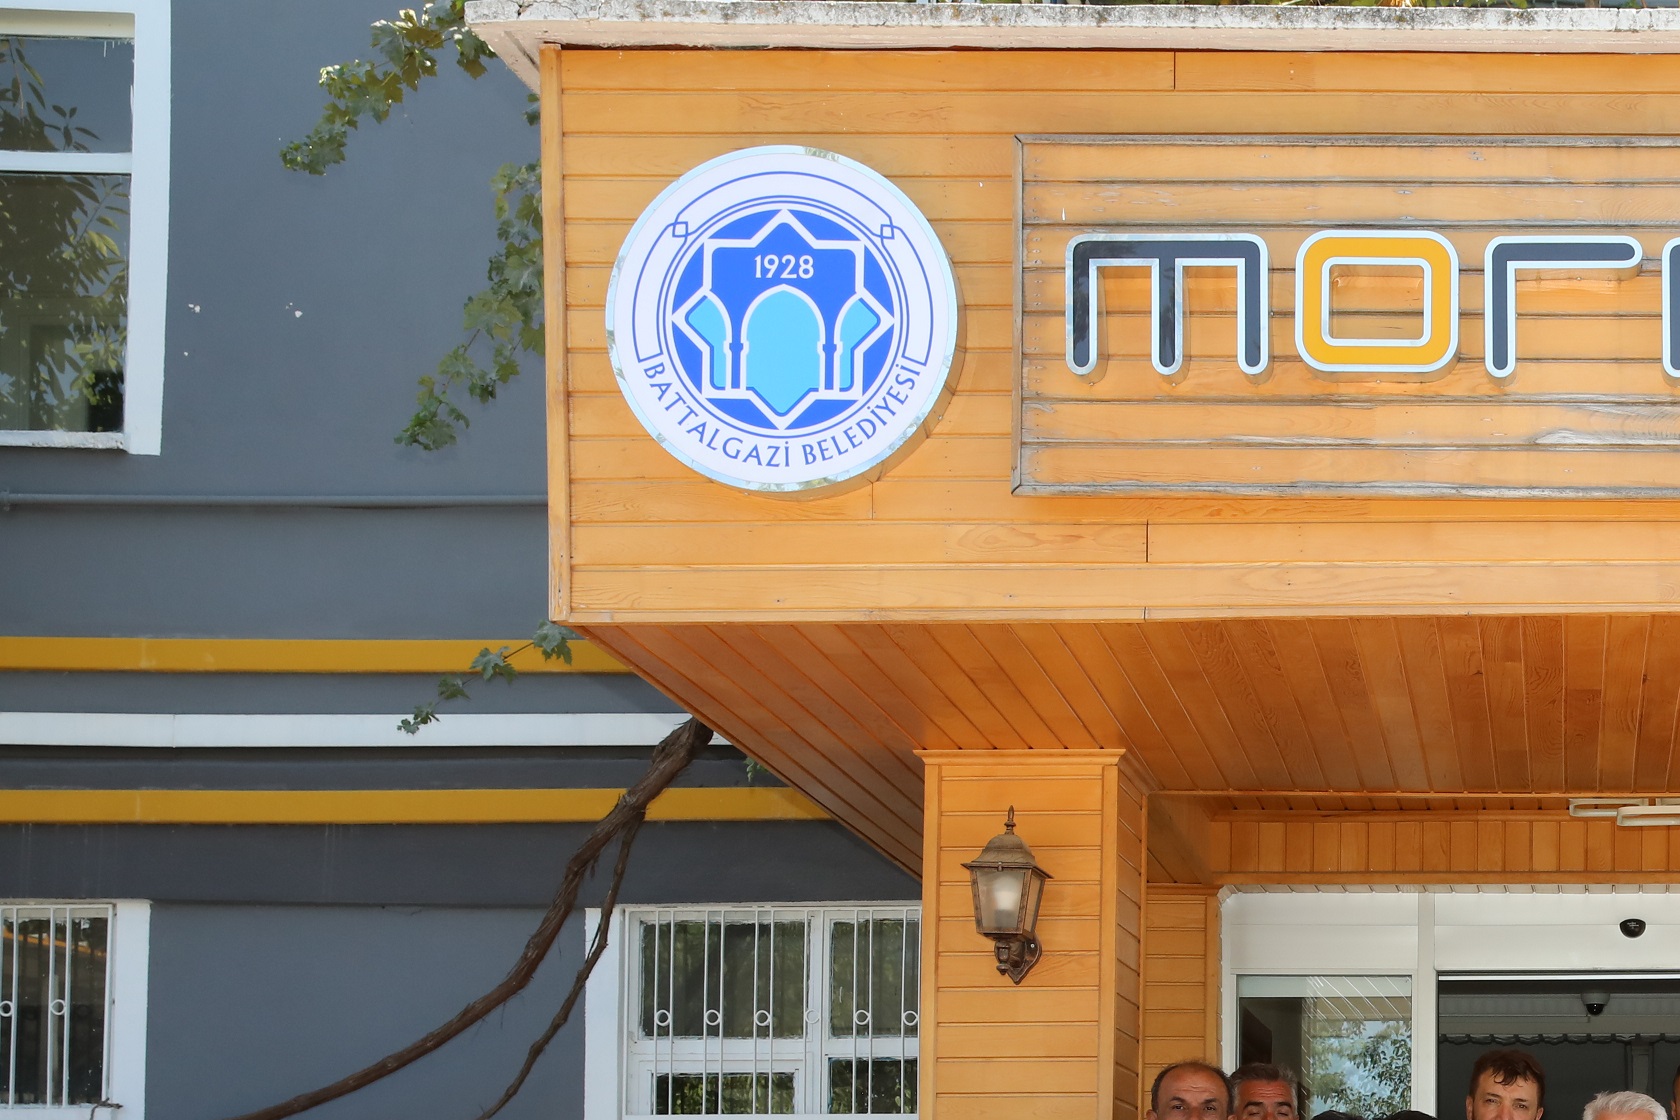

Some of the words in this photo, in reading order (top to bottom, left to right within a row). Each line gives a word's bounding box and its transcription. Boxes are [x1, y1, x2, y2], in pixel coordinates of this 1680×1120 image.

[754, 254, 815, 280] 1928
[643, 360, 790, 468] BATTALGAZİ
[803, 362, 921, 467] BELEDİYESİ
